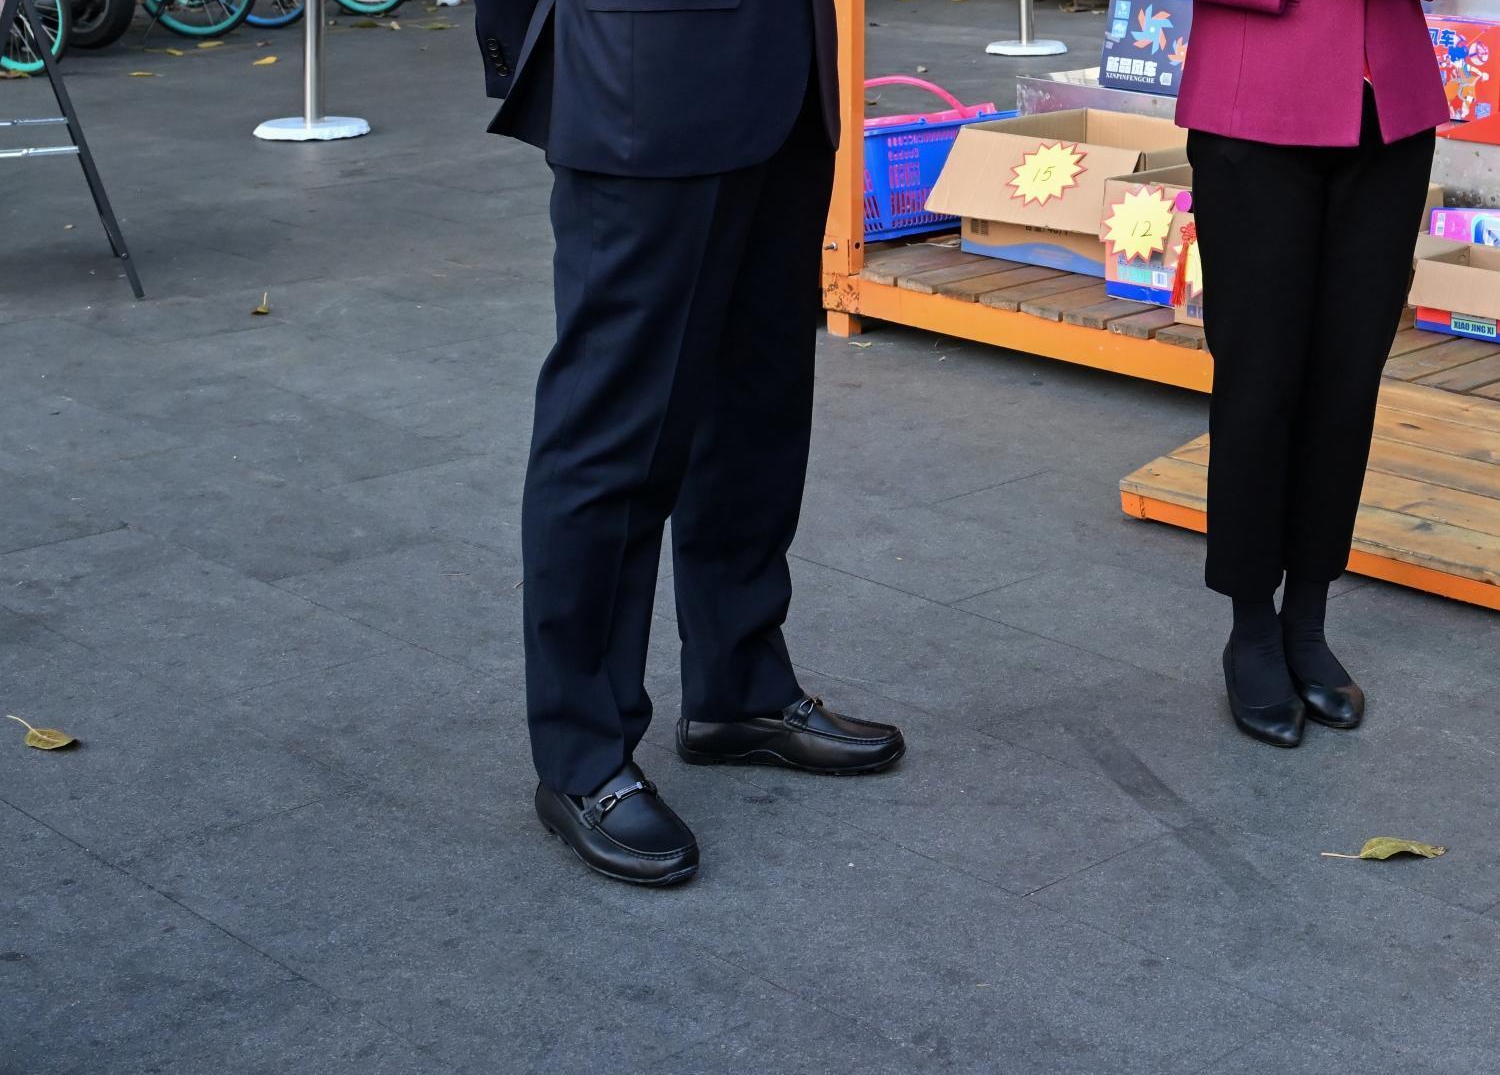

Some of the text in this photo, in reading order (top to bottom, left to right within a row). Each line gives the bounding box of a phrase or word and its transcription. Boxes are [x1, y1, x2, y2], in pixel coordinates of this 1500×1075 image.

[1105, 72, 1155, 84] XINPINFENGCHE
[1032, 166, 1056, 182] 15
[1131, 221, 1153, 238] 12
